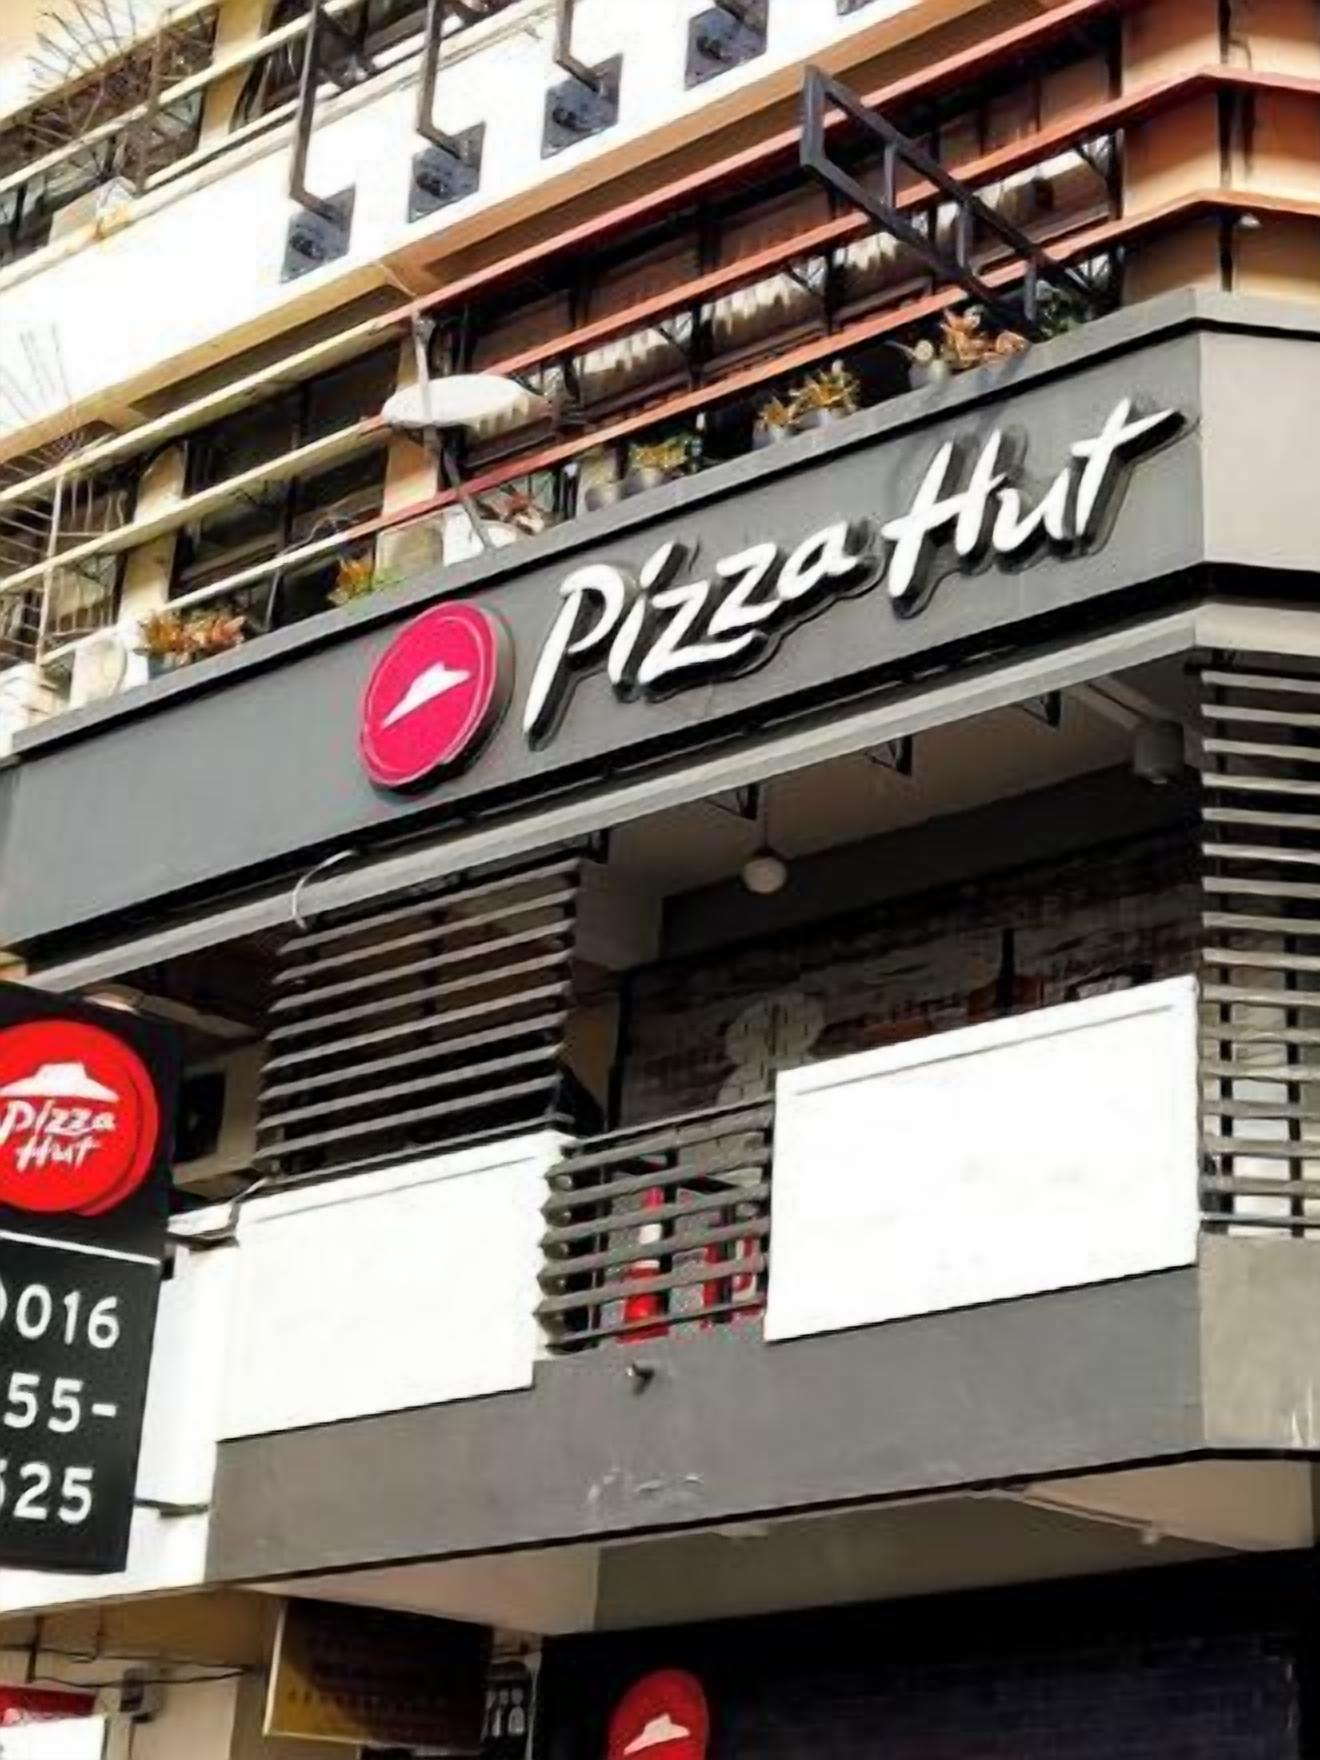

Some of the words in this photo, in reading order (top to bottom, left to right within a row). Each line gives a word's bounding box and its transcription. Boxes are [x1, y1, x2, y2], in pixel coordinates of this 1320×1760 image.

[522, 520, 862, 738] Pizza
[881, 396, 1184, 604] Hut
[0, 1098, 117, 1146] Pizza
[15, 1136, 101, 1173] Hut
[0, 1279, 120, 1349] 016
[0, 1457, 95, 1524] 25
